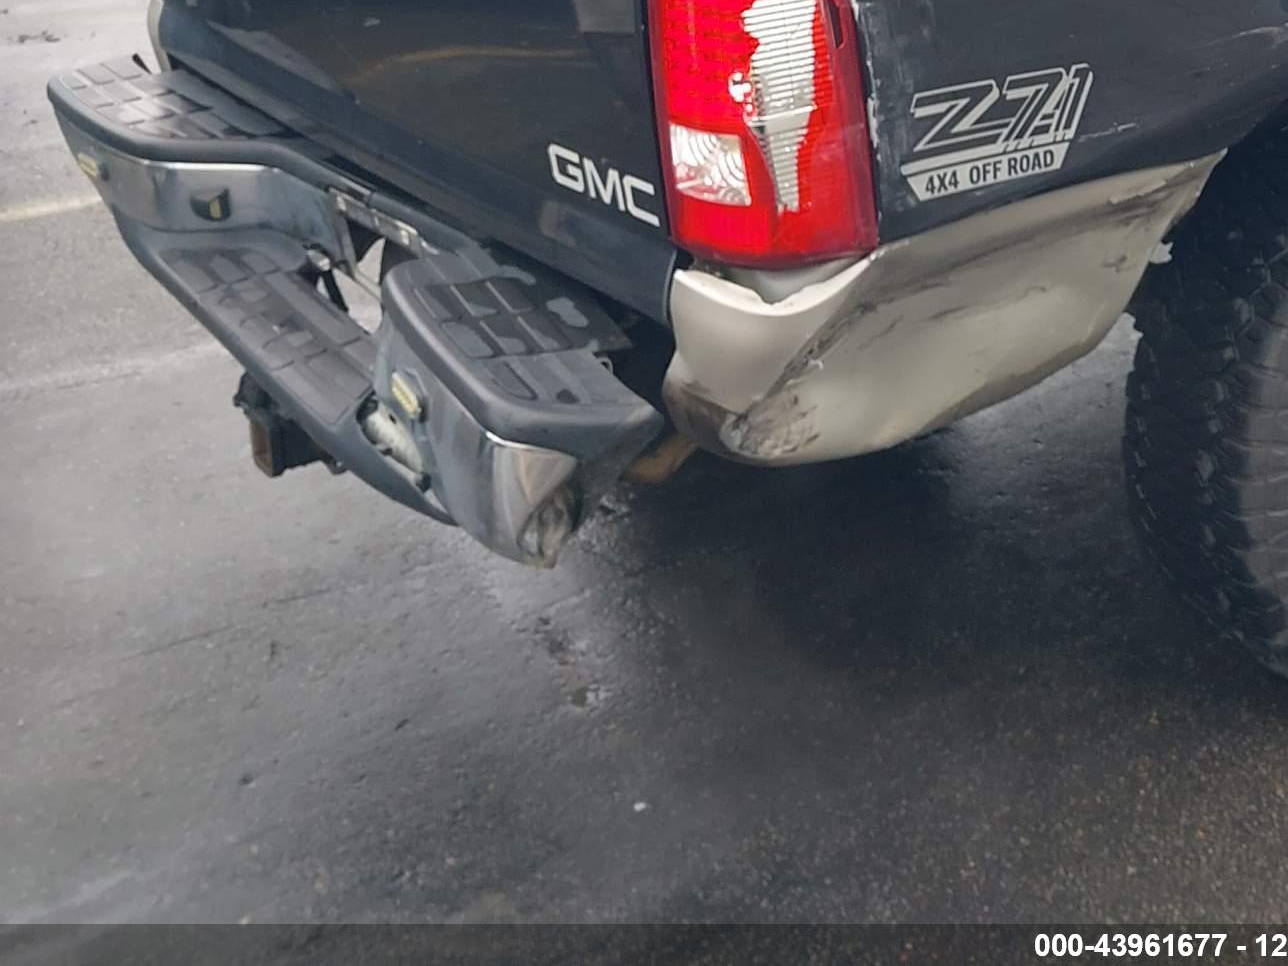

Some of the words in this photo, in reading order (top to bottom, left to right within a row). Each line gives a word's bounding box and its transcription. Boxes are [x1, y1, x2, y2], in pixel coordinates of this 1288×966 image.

[906, 62, 1094, 158] Z71
[547, 143, 661, 228] GMC
[924, 170, 960, 195] 4X4
[968, 160, 1003, 186] OFF
[1007, 149, 1055, 177] ROAD
